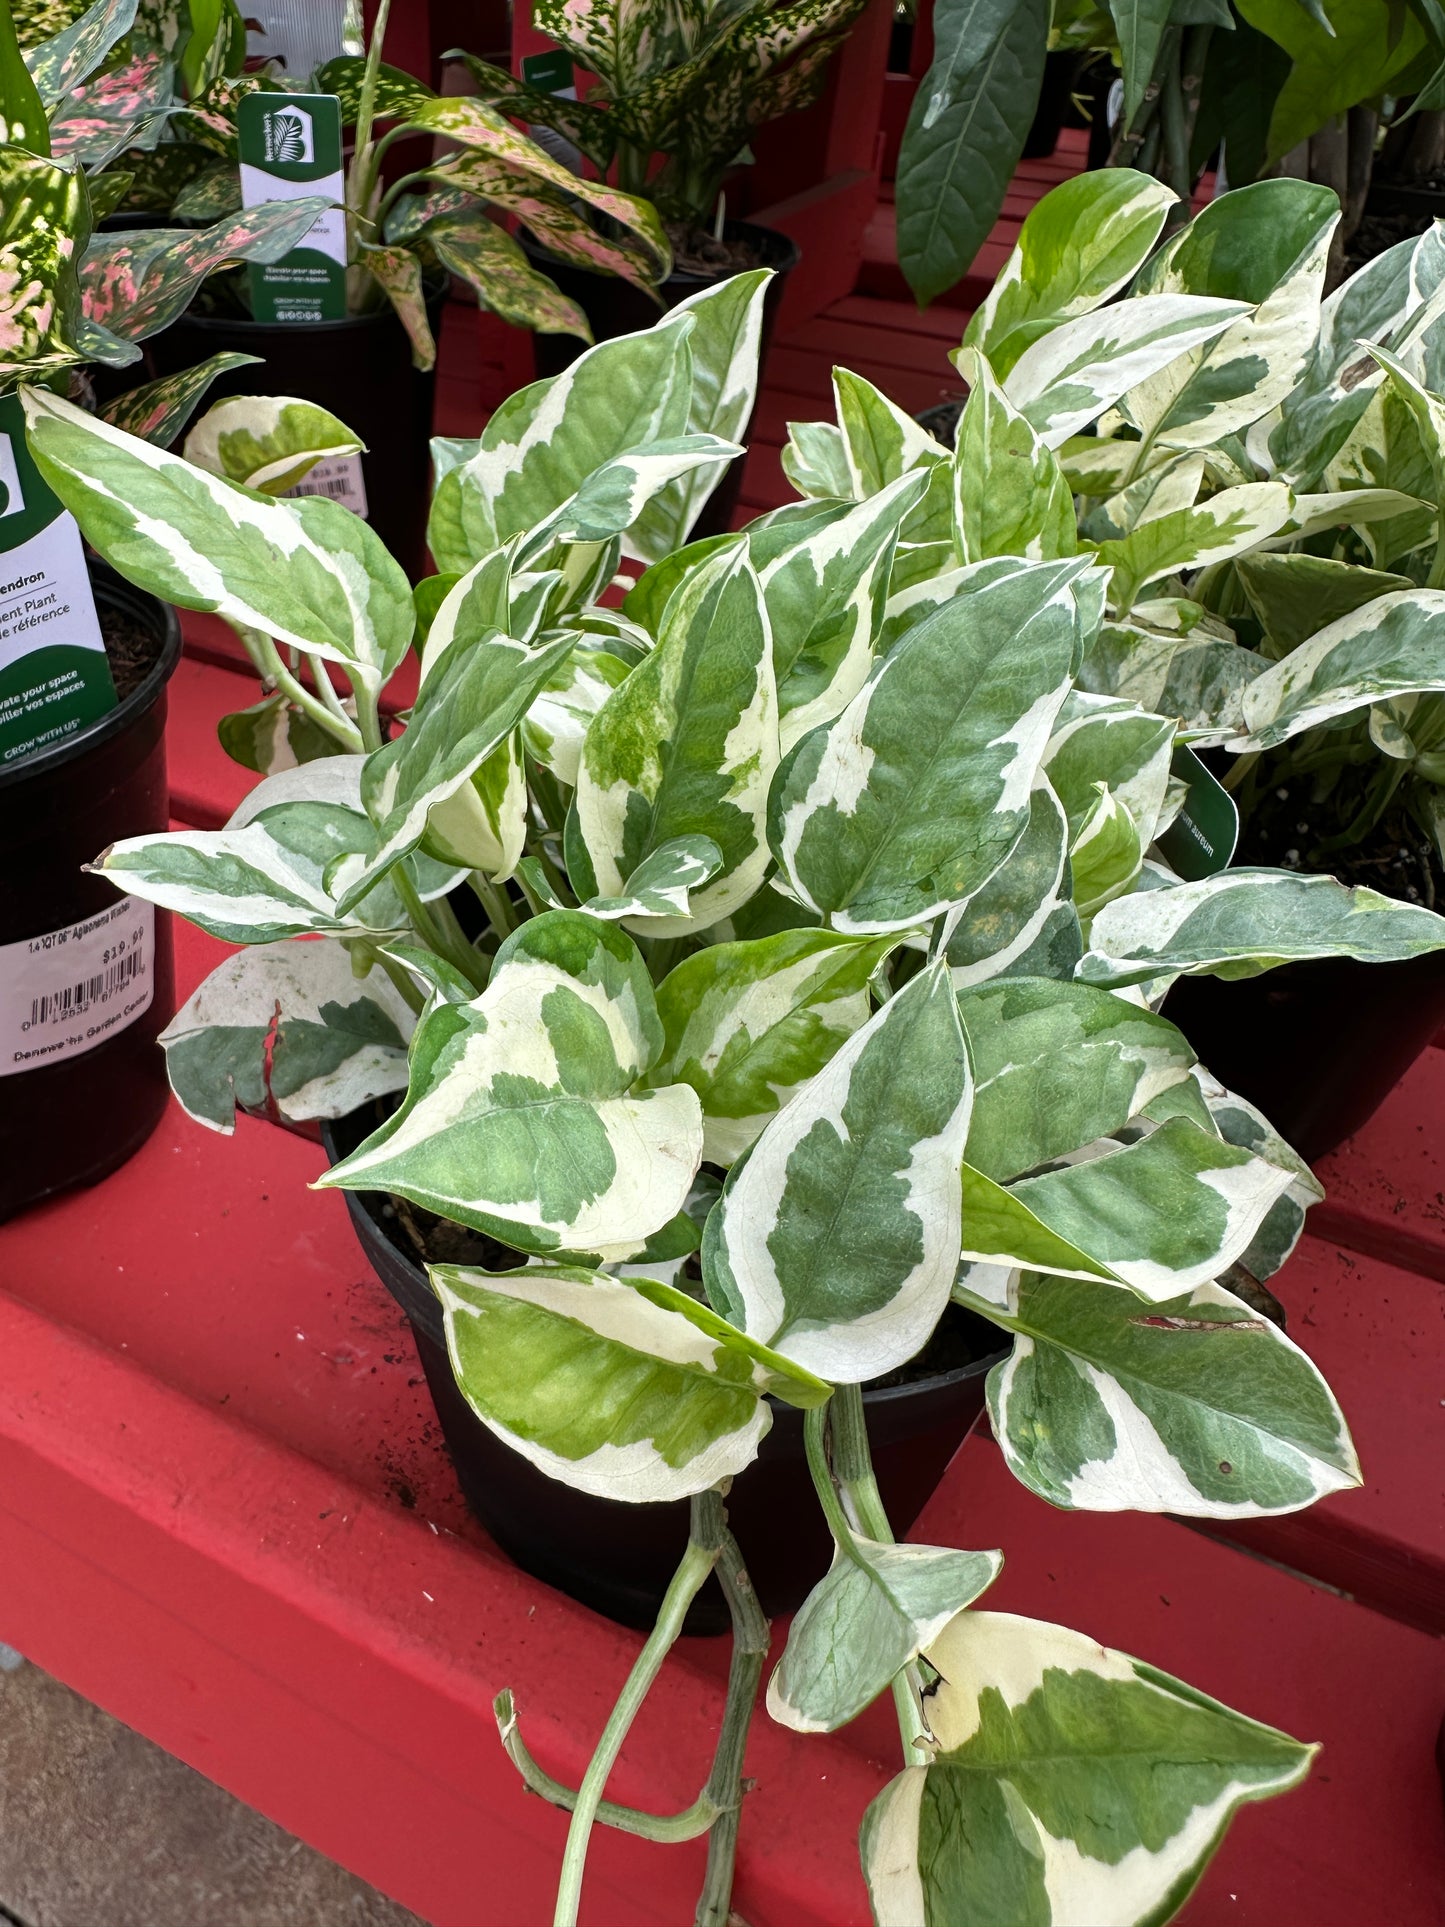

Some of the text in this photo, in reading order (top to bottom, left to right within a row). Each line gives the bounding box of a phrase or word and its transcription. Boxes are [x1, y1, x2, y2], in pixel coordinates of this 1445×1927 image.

[24, 592, 57, 612] Plant
[13, 604, 70, 634] référence
[22, 683, 47, 703] your
[48, 670, 78, 689] space
[26, 698, 44, 712] vos
[46, 680, 85, 704] espaces
[4, 738, 35, 760] GROW
[36, 725, 64, 743] WITH
[1191, 824, 1214, 858] aureum
[103, 925, 144, 964] $19.99
